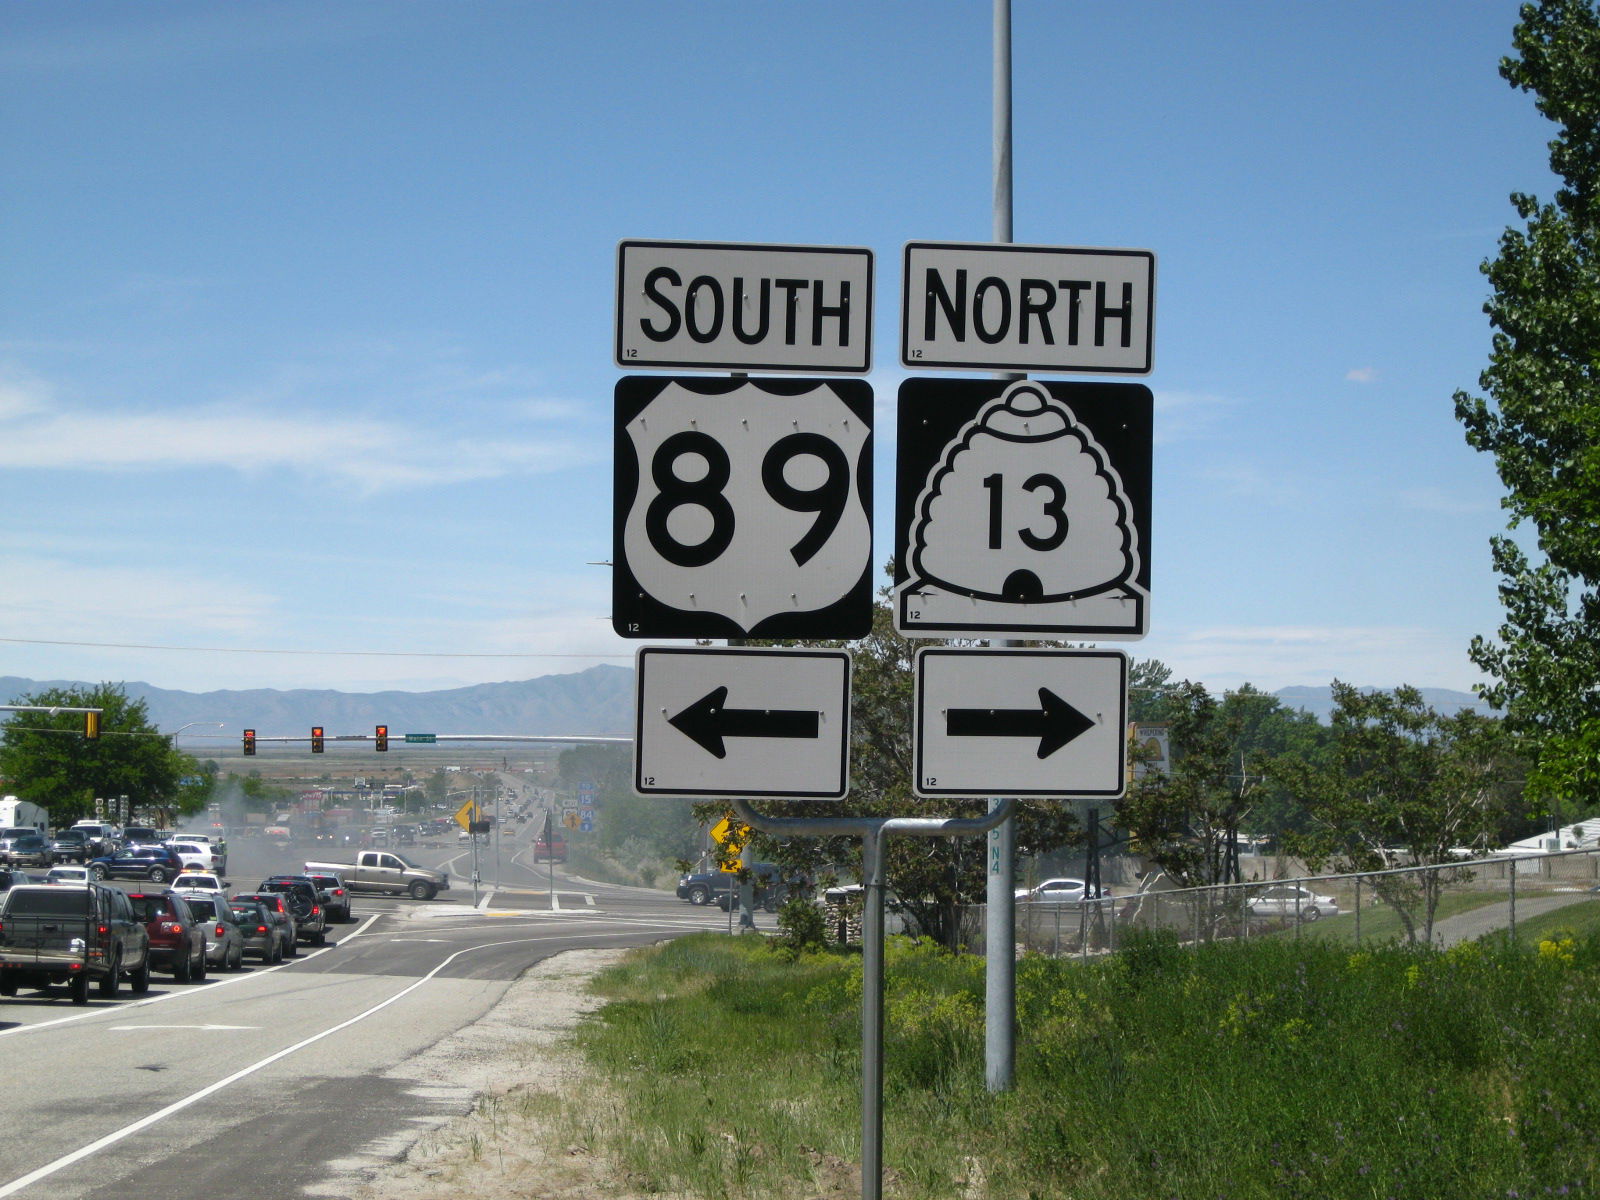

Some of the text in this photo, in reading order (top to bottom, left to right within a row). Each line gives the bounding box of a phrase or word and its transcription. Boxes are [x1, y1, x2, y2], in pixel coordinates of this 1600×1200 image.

[639, 266, 851, 347] SOUTH
[924, 267, 1133, 348] NORTH
[626, 348, 638, 358] 12
[911, 349, 923, 359] 12
[645, 430, 851, 568] 89
[983, 472, 1070, 552] 13
[909, 610, 921, 620] 12
[628, 623, 639, 632] 12
[644, 776, 656, 786] 12
[926, 777, 937, 786] 12
